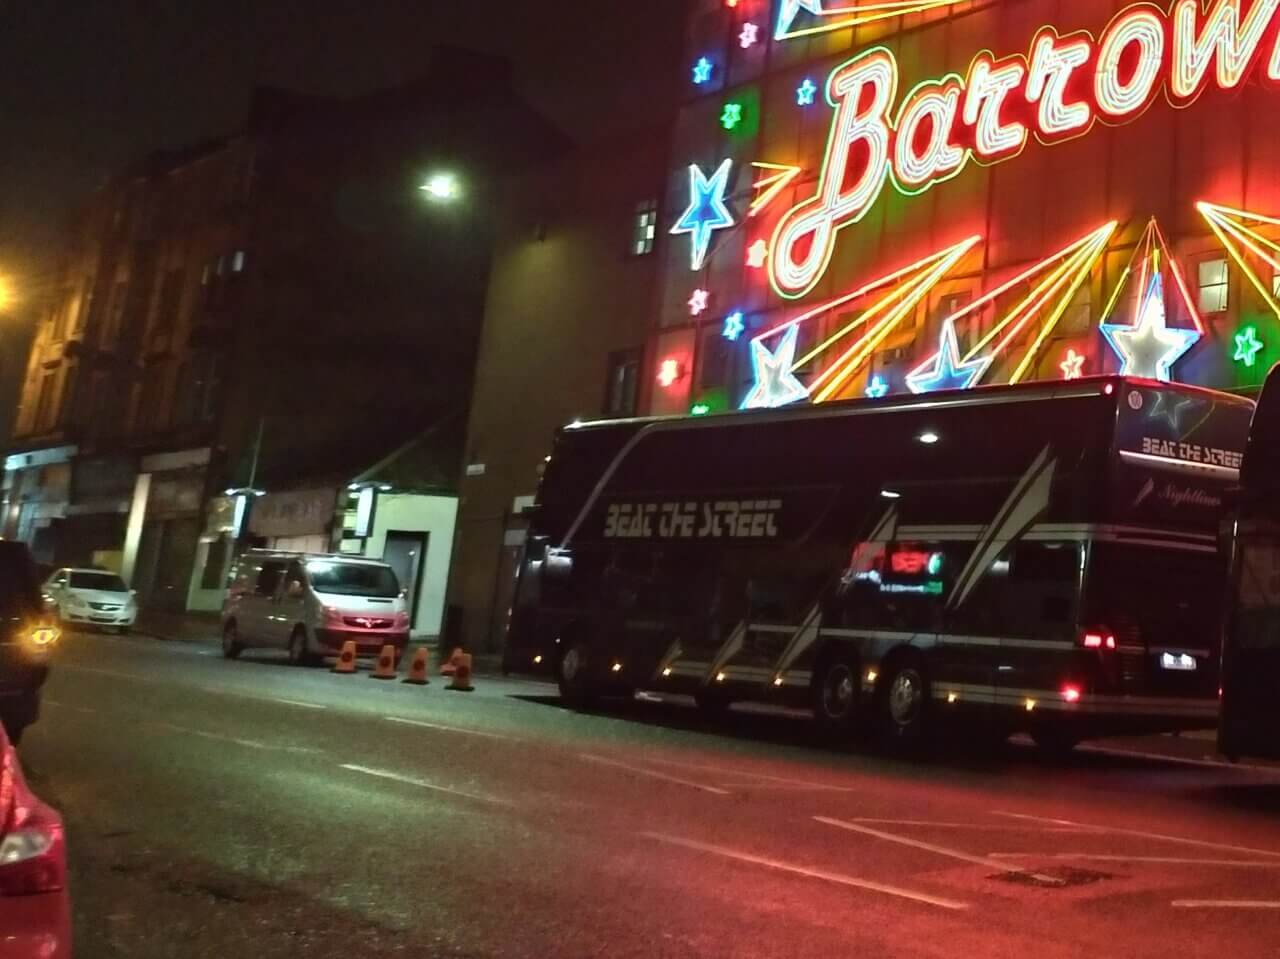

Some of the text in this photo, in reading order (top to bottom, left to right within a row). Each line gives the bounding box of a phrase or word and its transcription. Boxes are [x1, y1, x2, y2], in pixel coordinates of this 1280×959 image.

[1143, 437, 1177, 457] BEAT
[1179, 442, 1201, 462] THE
[603, 499, 782, 538] BEAT THE STREET
